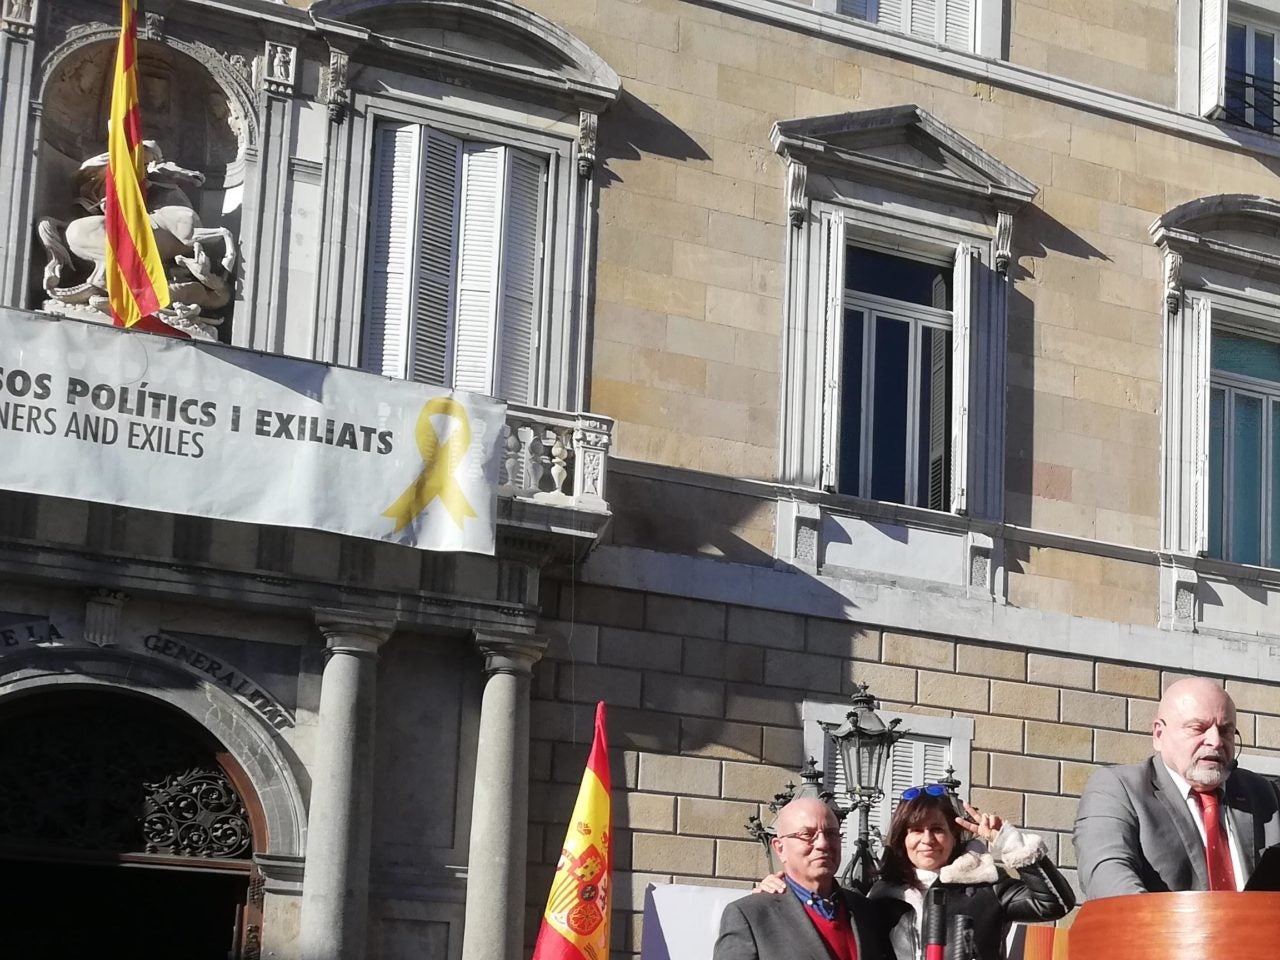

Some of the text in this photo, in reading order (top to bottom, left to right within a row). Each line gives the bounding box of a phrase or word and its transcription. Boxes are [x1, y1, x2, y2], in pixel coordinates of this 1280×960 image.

[0, 367, 393, 455] OS POLÍTICS I EXILIATS
[64, 411, 119, 445] AND
[128, 422, 204, 459] EXILES
[25, 623, 64, 642] LA
[143, 635, 295, 730] GENERALITAT
